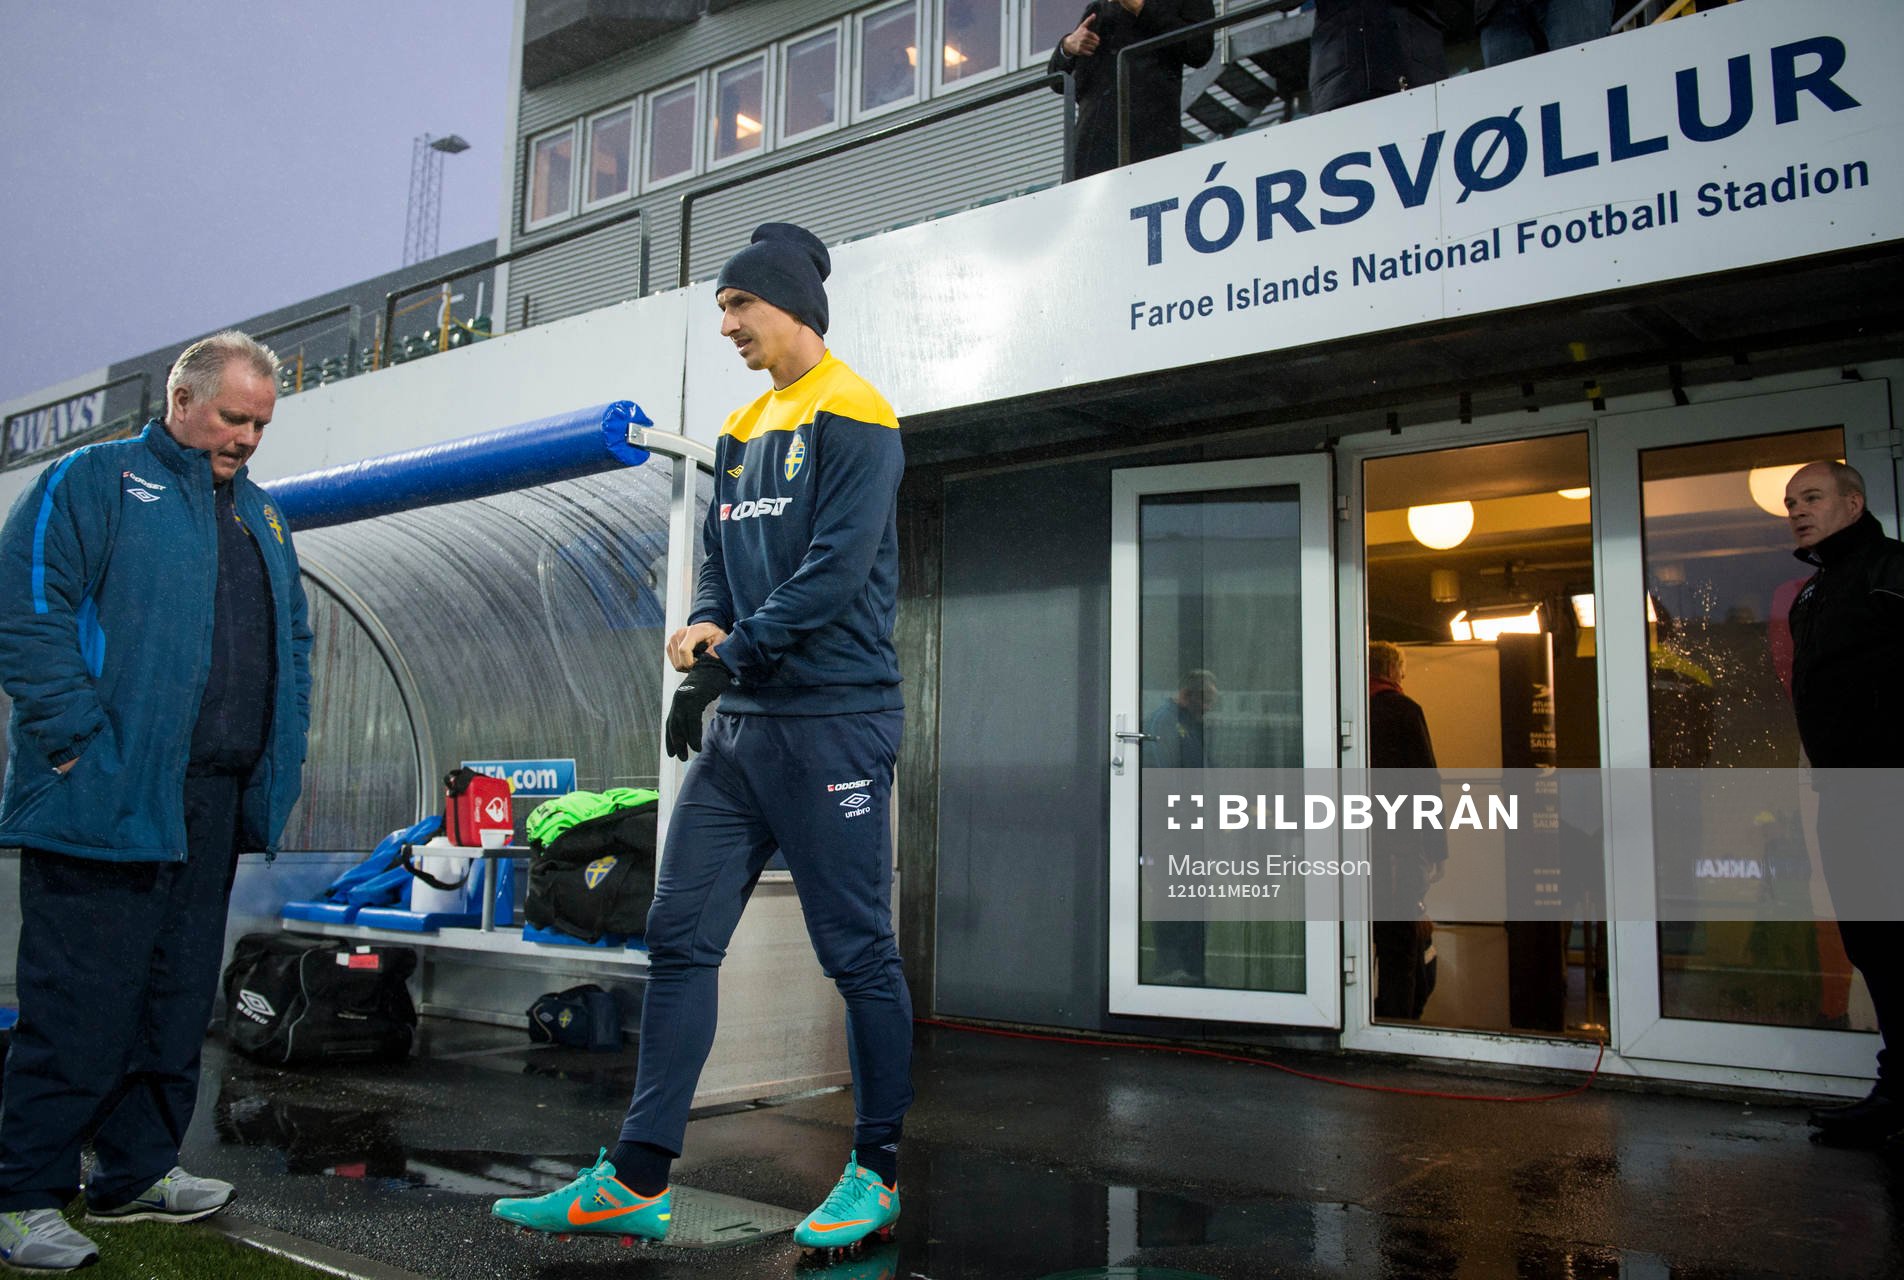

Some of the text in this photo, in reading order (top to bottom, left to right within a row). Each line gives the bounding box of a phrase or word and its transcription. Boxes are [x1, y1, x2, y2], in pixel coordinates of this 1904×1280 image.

[1130, 35, 1862, 266] TÓRSVØLLUR
[1131, 160, 1870, 330] Faroe Islands National Football Stadion
[845, 806, 871, 819] umbro
